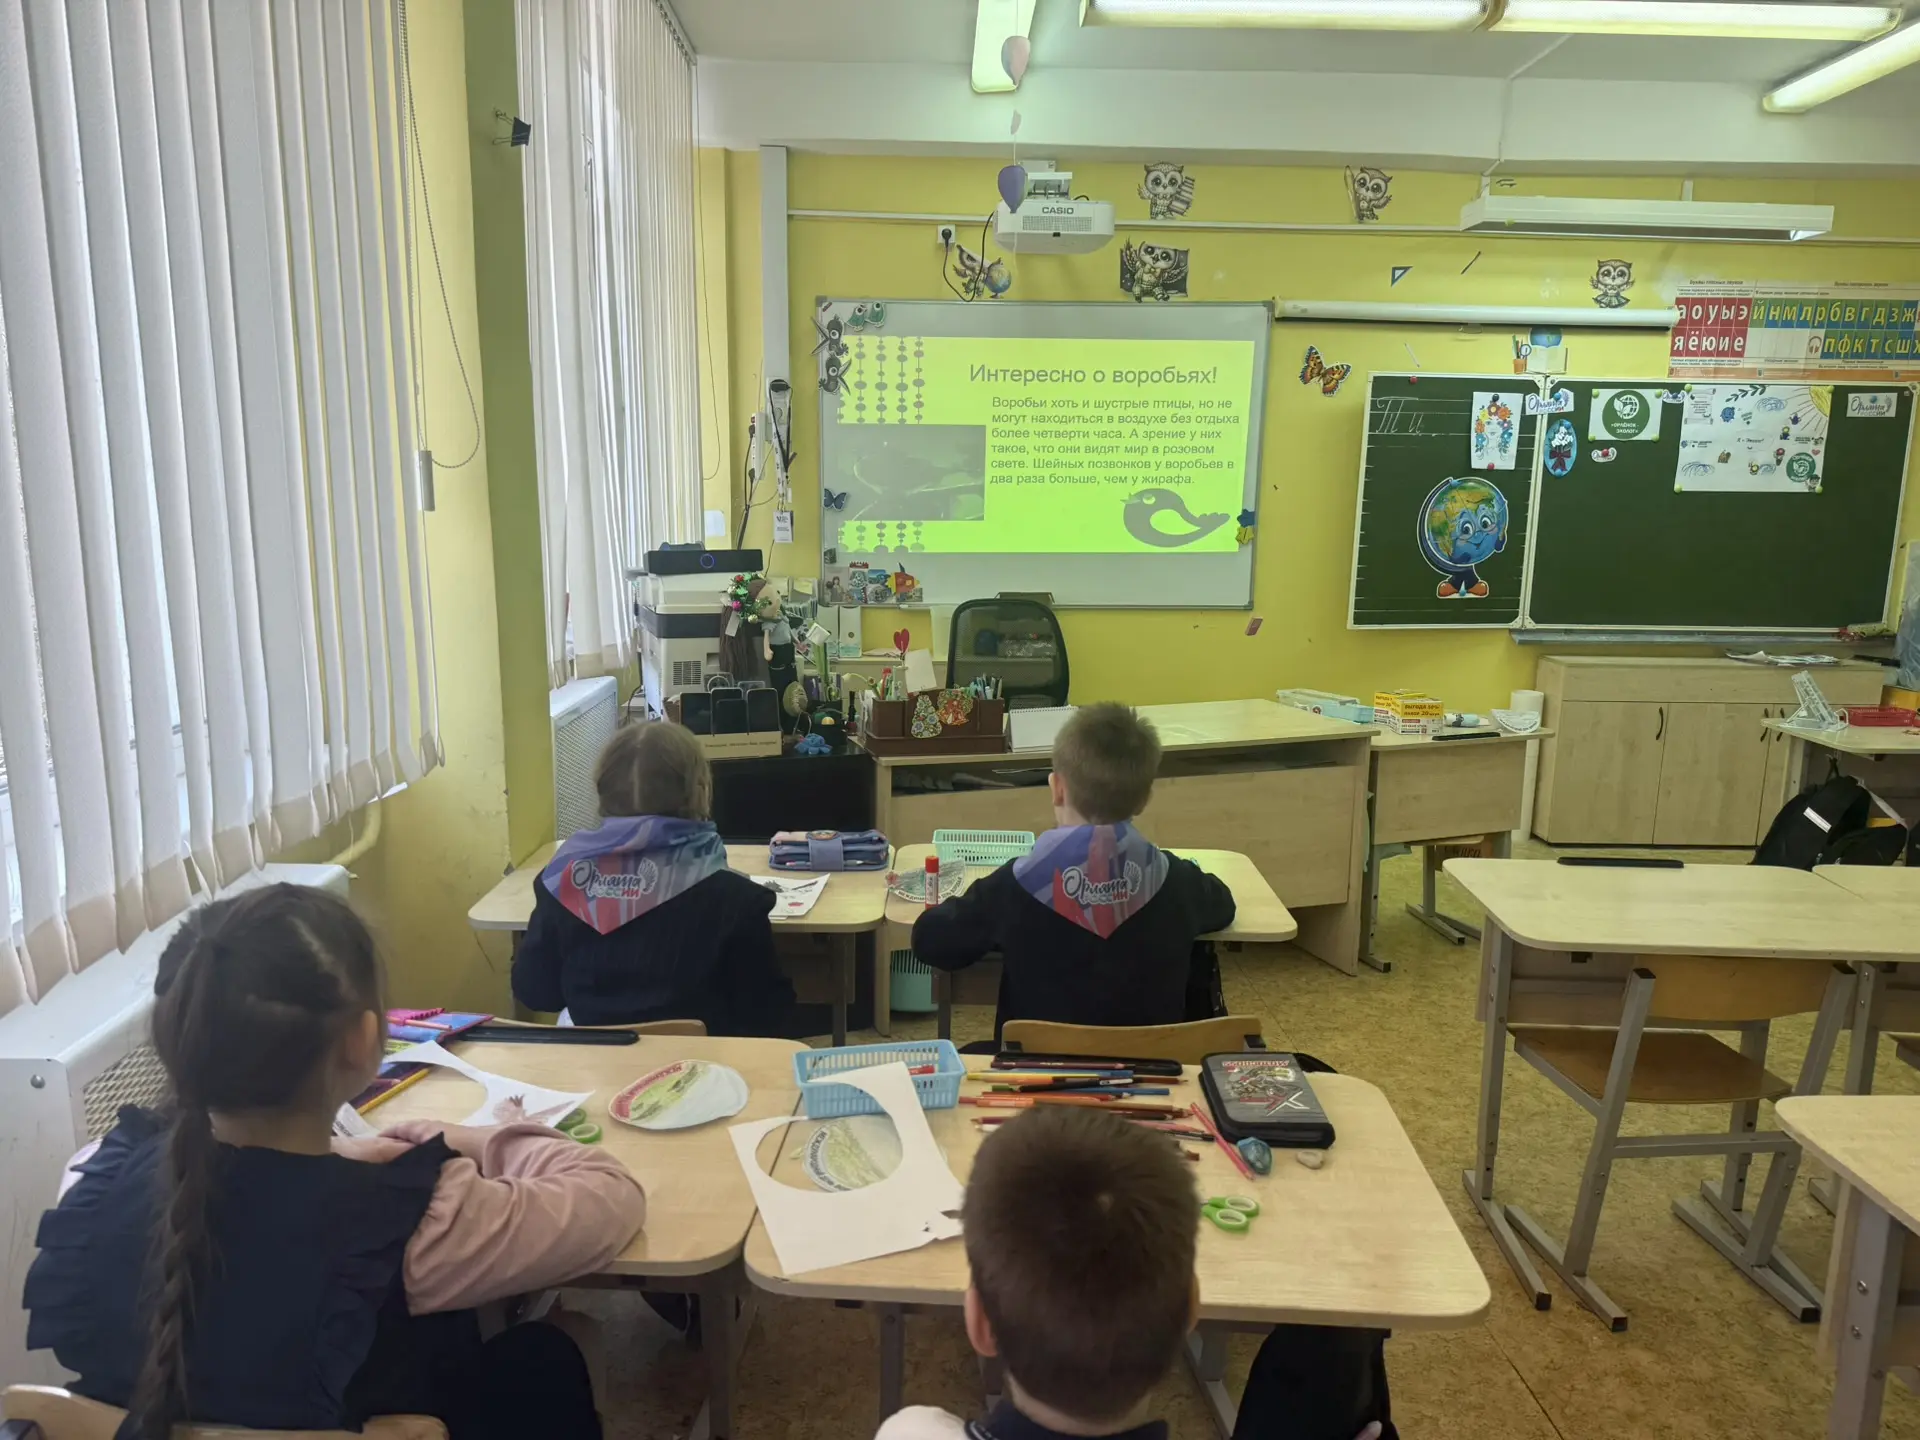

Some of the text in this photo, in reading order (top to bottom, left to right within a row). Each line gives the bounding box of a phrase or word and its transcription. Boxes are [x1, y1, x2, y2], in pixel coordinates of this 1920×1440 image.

[1042, 206, 1074, 215] CASIO
[969, 364, 1218, 388] Интересно о воробьях!
[992, 396, 1233, 411] Воробьи хоть и шустрые птицы, но не
[991, 413, 1240, 426] могут находиться в воздухе без отдыха
[991, 427, 1222, 441] более четверти часа. А зрение у них
[991, 445, 1215, 456] такое, что они видят мир в розовом
[990, 458, 1234, 471] свете. Шейных позвонков у воробьев в
[990, 473, 1195, 487] два раза больше, чем у жирафа.
